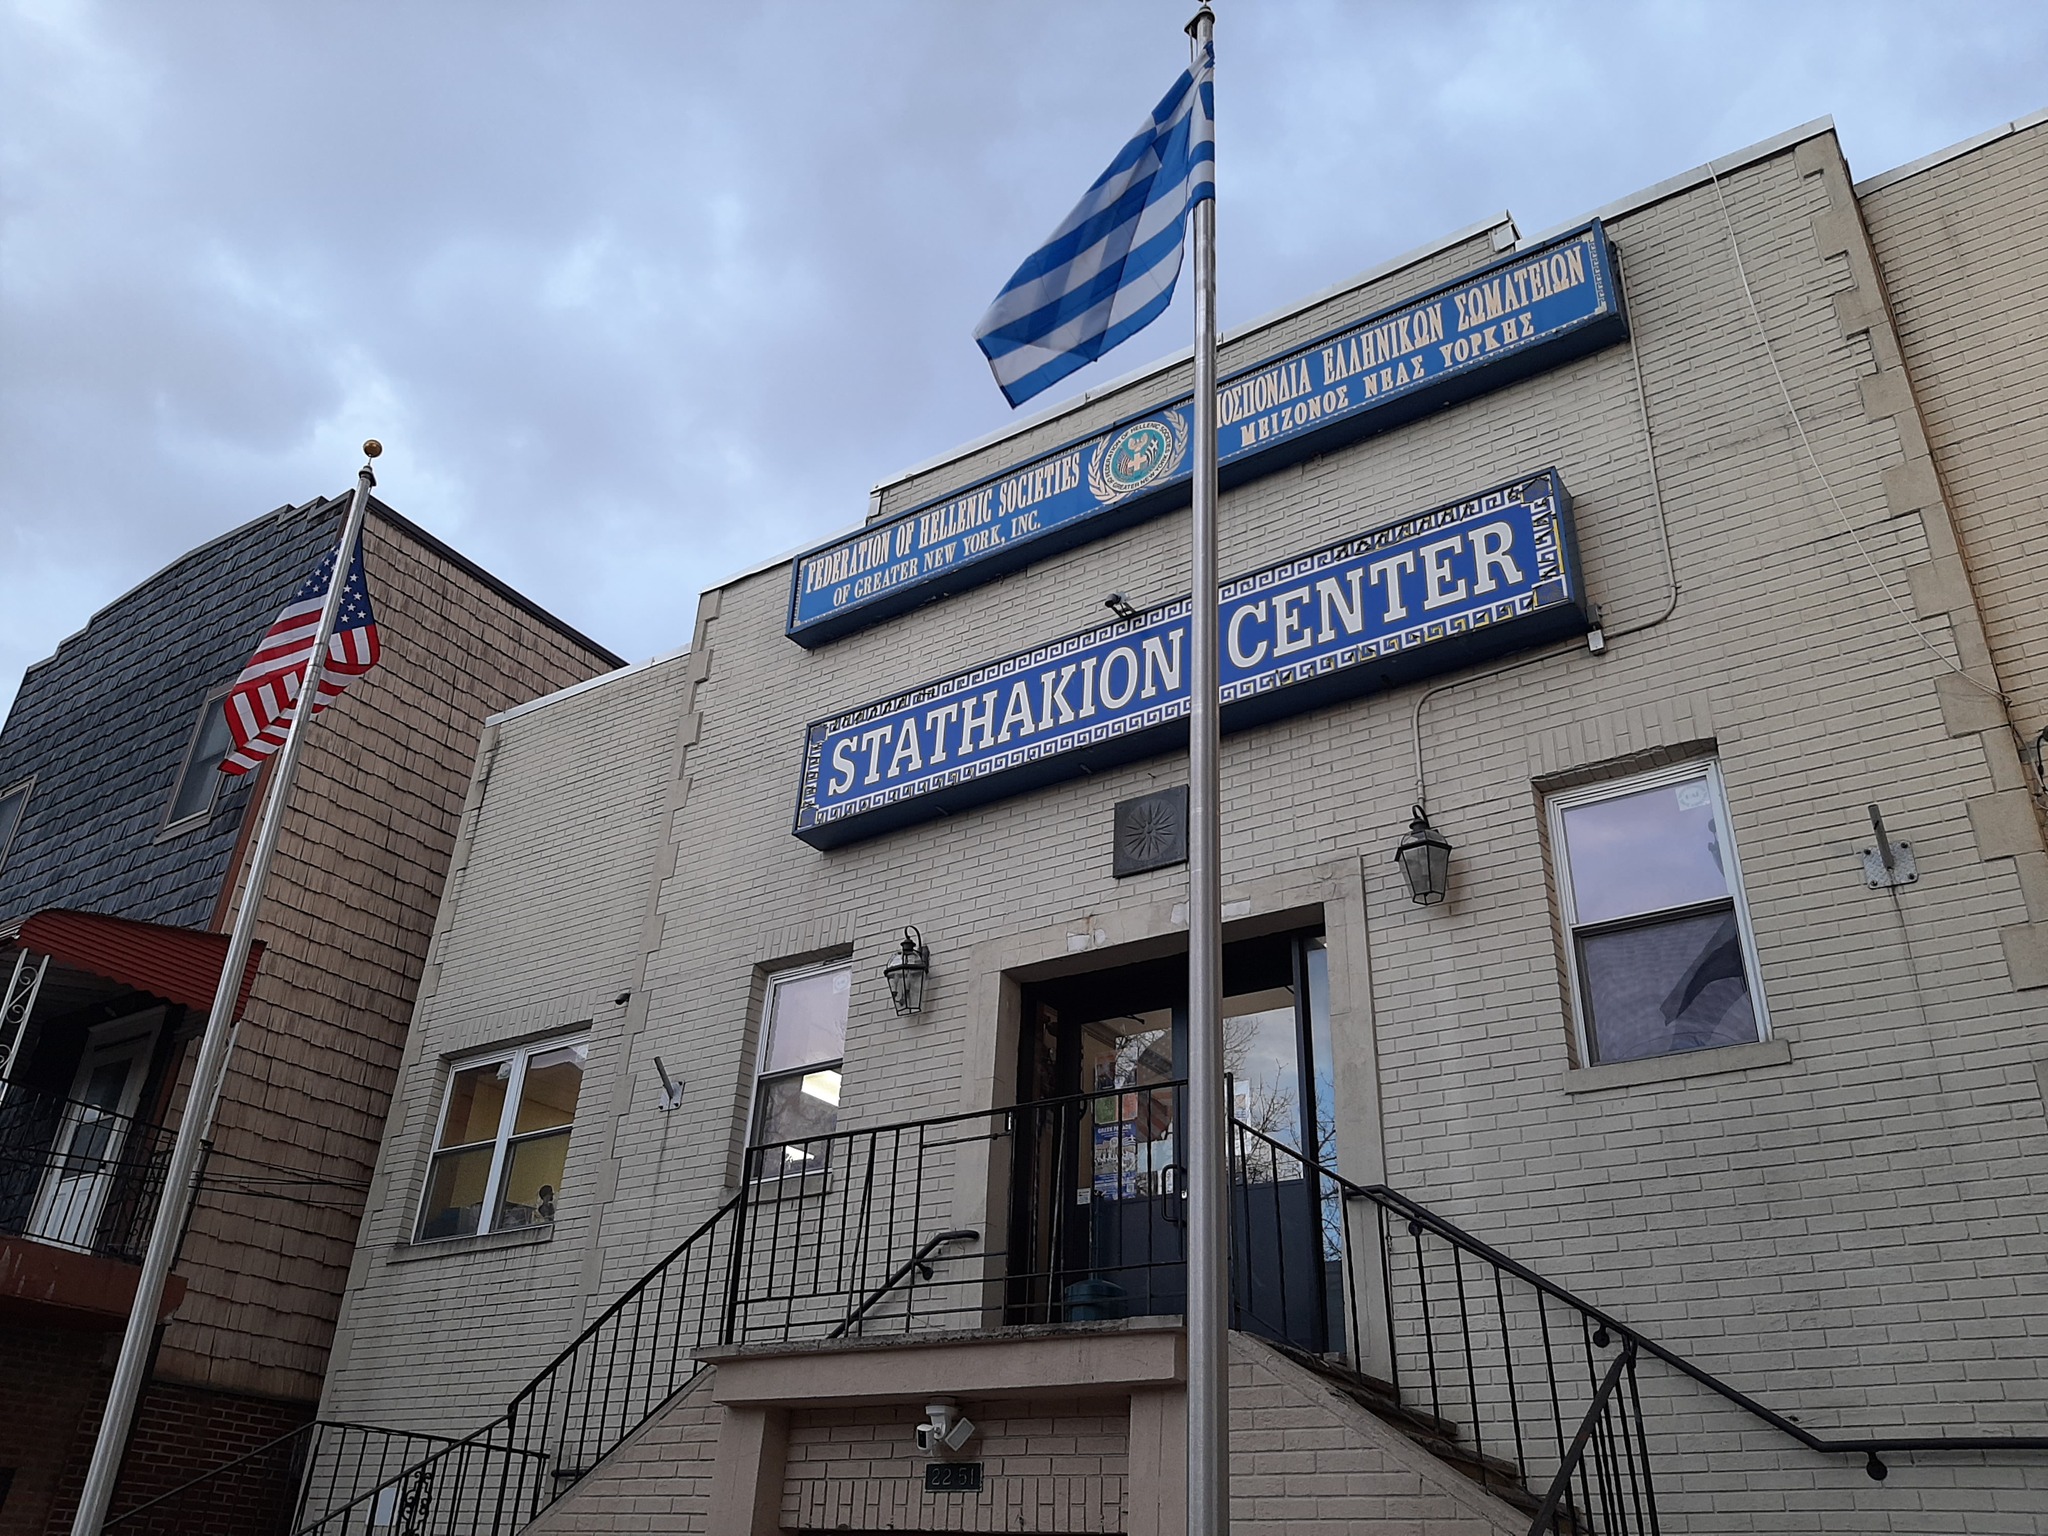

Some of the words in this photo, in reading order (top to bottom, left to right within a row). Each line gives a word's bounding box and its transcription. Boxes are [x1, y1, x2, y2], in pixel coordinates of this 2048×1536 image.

[1241, 385, 1349, 448] ΜΕΙΖΟΝΟΣ
[1363, 355, 1425, 399] ΝΕΑΣ
[1439, 312, 1534, 368] ΥΟΡΚΗΣ
[1322, 303, 1444, 386] ΕΛΛΗΝΙΚΩΝ
[1454, 245, 1585, 332] ΣΩΜΑΤΕΙΩΝ
[805, 530, 892, 594] FEDERATION
[895, 521, 915, 558] OF
[918, 488, 993, 549] HELLENIC
[999, 452, 1080, 517] SOCIETIES
[1140, 471, 1155, 484] NEW
[833, 584, 851, 607] OF
[854, 557, 918, 598] GREATER
[923, 541, 957, 573] NEW
[963, 524, 1006, 557] YORK,
[1011, 510, 1041, 539] INC.
[828, 627, 1184, 797] STATHAKION
[1227, 521, 1523, 669] CENTER
[931, 1468, 951, 1485] 22
